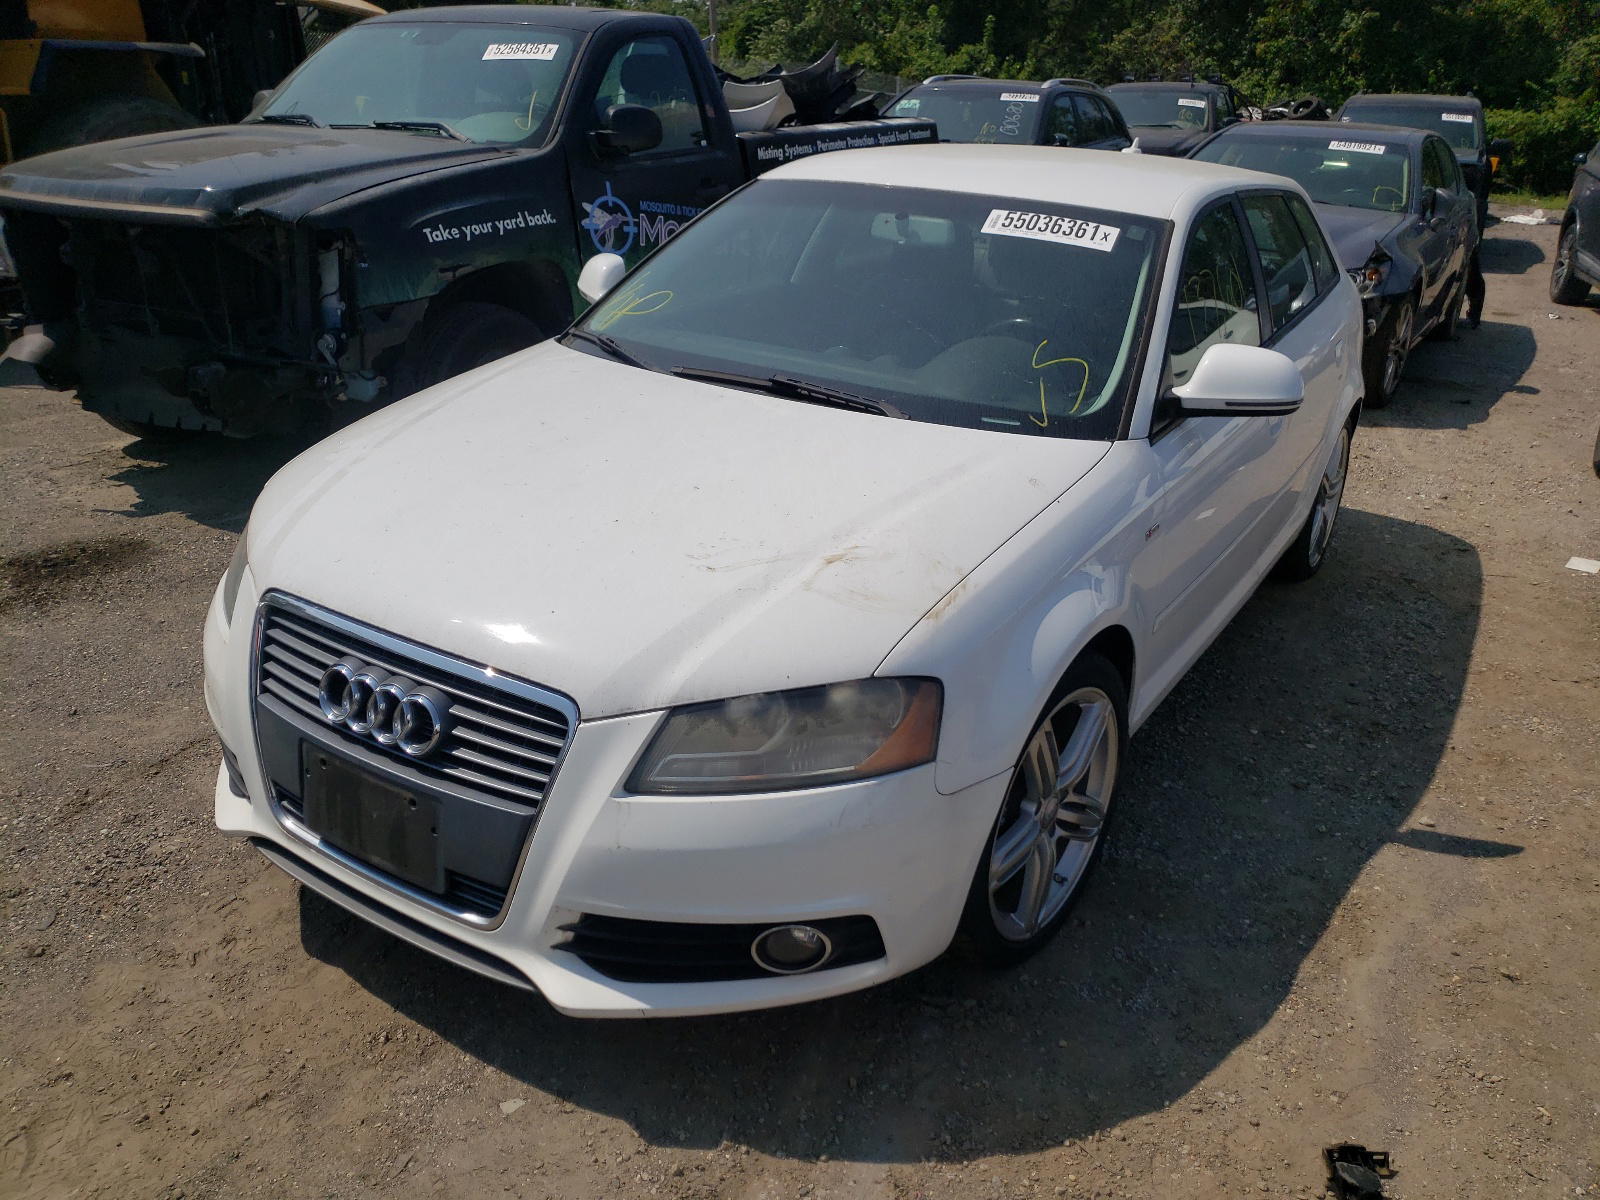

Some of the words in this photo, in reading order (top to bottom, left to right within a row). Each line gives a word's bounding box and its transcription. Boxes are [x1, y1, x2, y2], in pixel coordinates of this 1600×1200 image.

[757, 146, 784, 160] Misting
[784, 143, 813, 160] Systems
[817, 138, 847, 152] Perimeter
[847, 135, 875, 148] Protection
[640, 200, 676, 215] MOSQUITO
[423, 224, 460, 243] Take
[461, 221, 493, 241] your
[495, 211, 526, 235] yard
[524, 209, 556, 226] back.
[640, 213, 688, 246] Mo
[1001, 211, 1101, 241] 55036361
